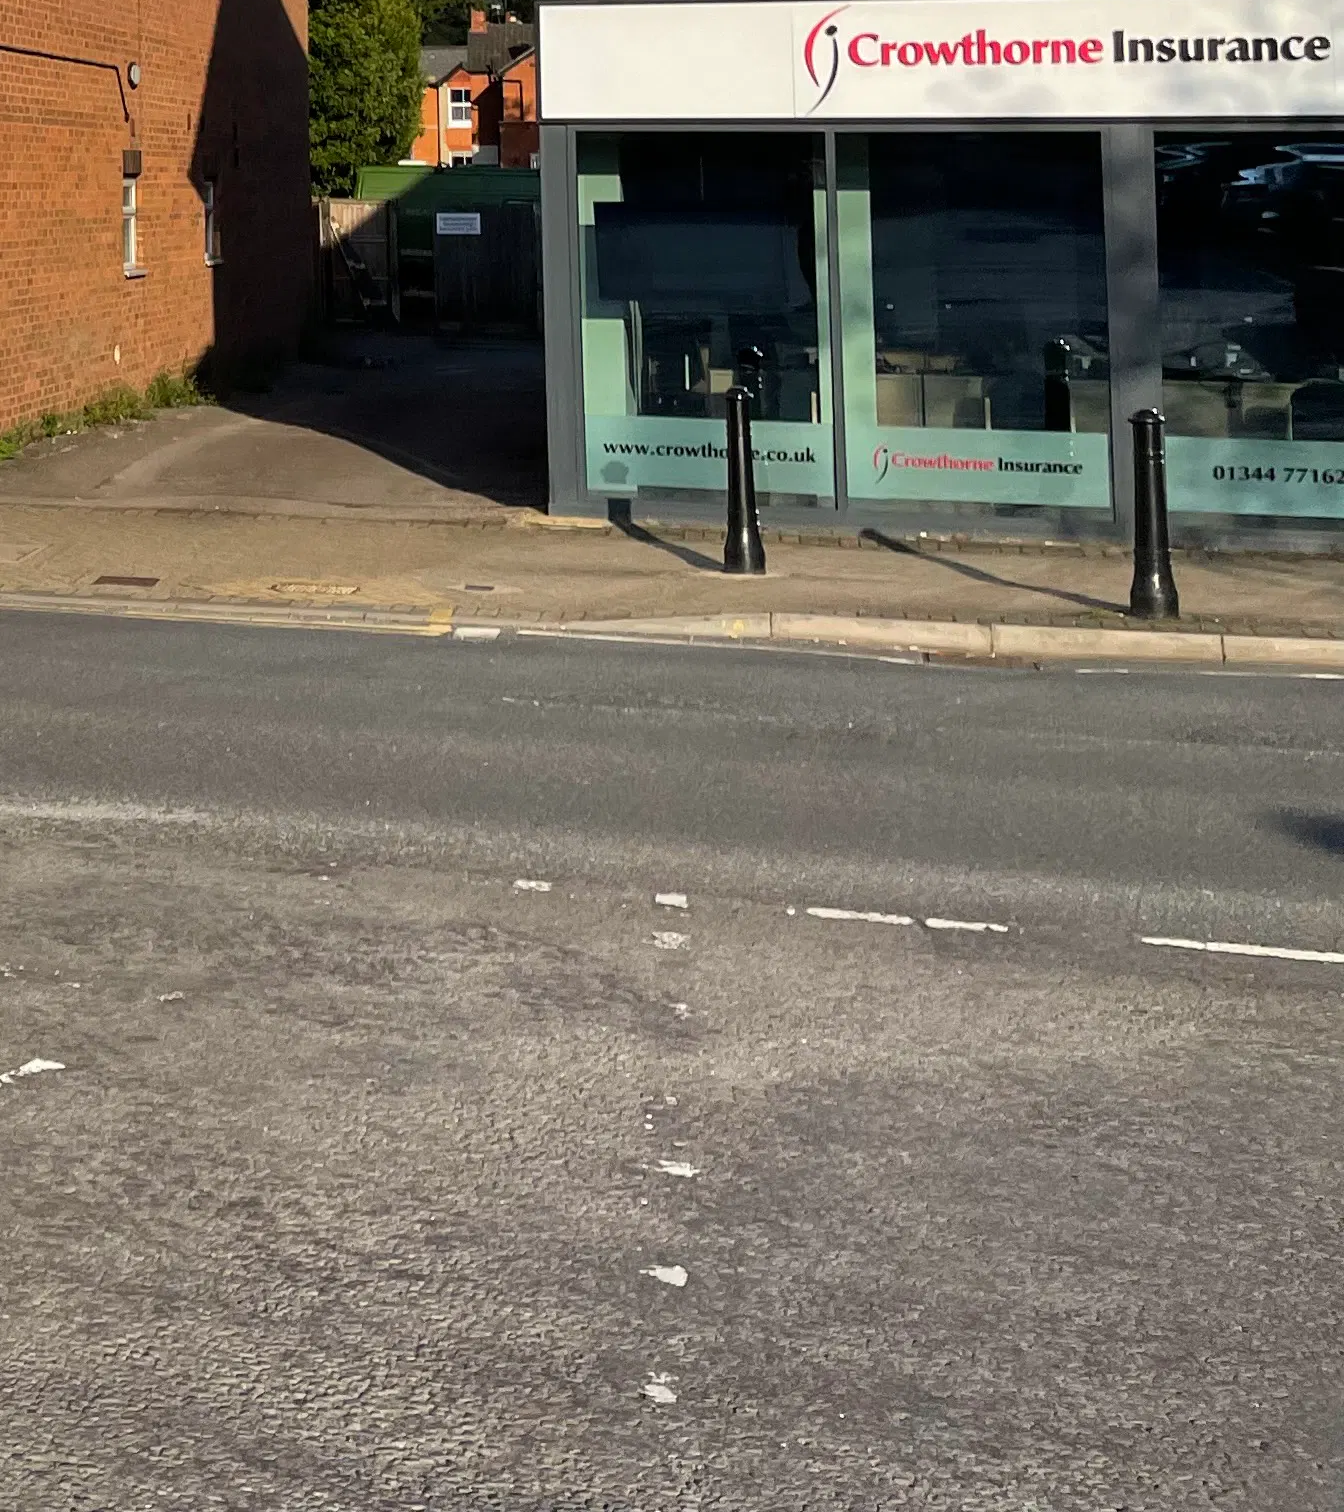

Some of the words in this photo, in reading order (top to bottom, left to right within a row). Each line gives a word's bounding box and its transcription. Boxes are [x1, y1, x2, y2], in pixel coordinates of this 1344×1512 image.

[848, 29, 1104, 68] Crowthorne
[1112, 29, 1331, 64] Insurance
[603, 443, 816, 464] www.crowthoe.co.uk
[891, 452, 994, 473] Crowthorne
[998, 456, 1083, 475] Insurance
[1213, 465, 1275, 482] 01344
